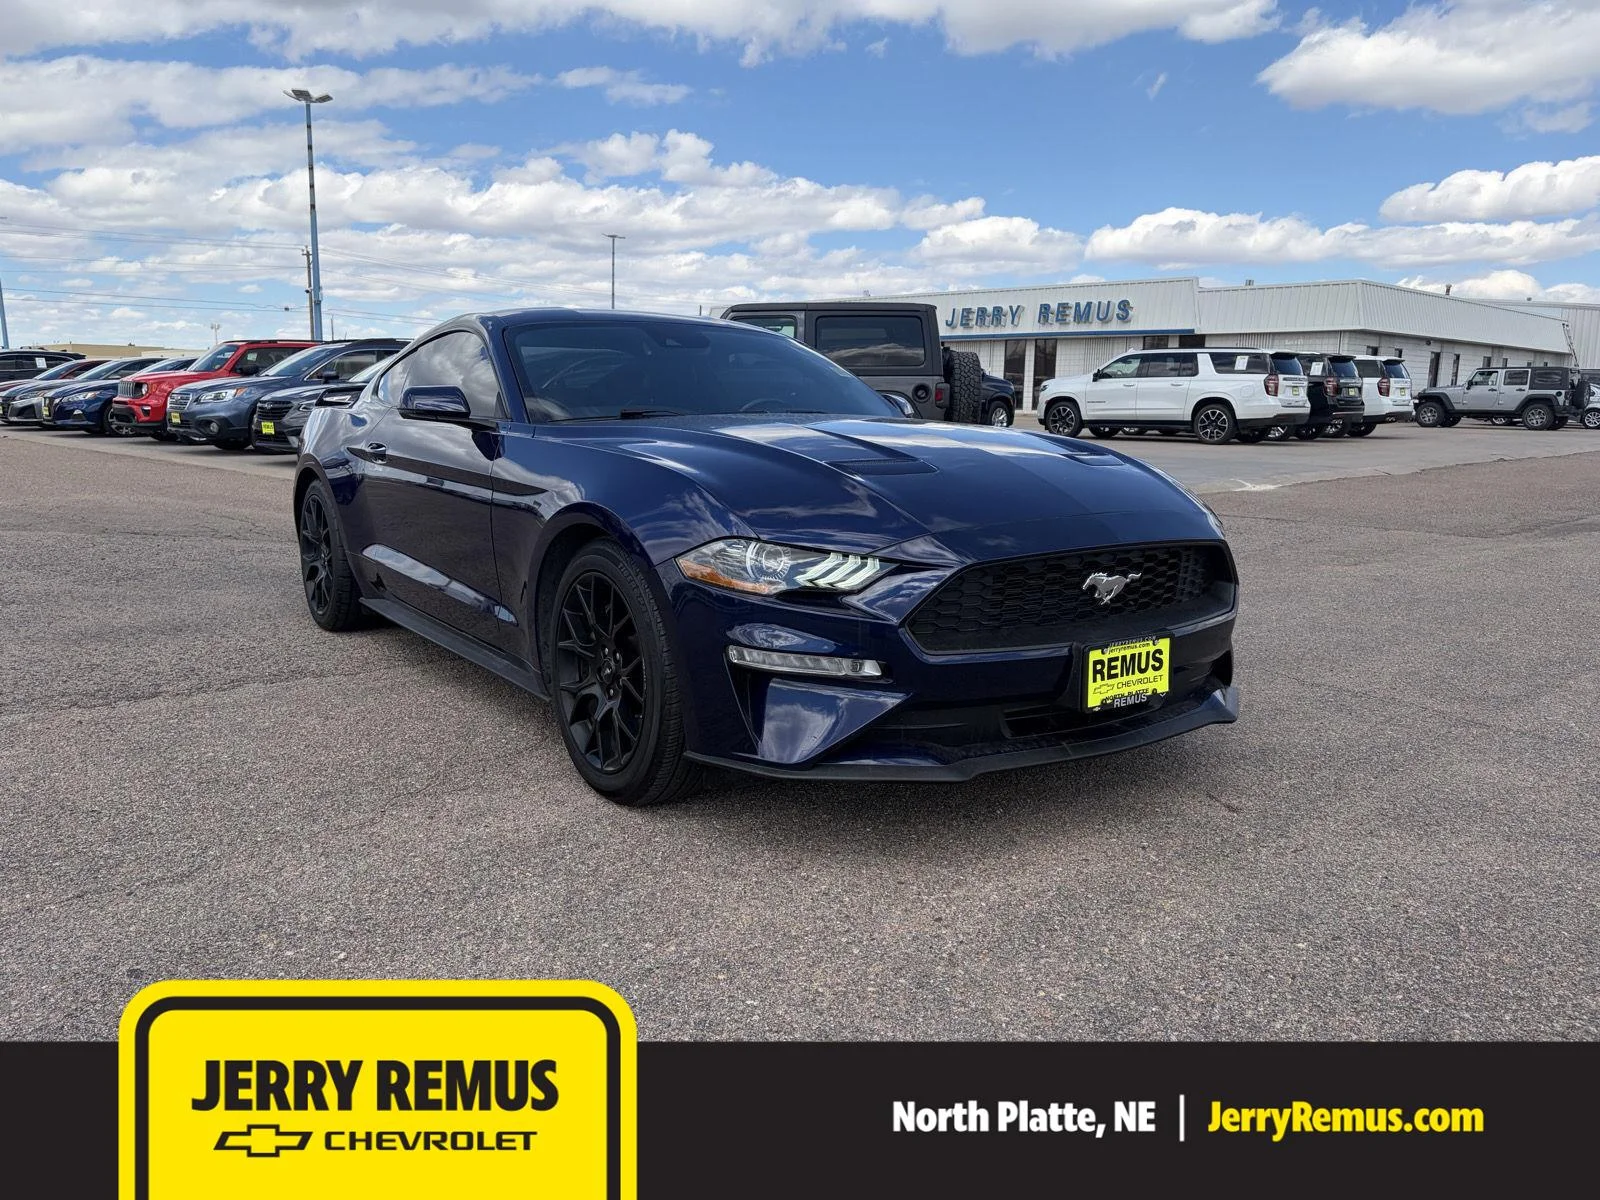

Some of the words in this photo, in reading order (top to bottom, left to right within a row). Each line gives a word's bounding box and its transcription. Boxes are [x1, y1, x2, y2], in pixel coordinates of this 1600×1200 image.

[945, 304, 1023, 328] JERRY
[1038, 299, 1132, 325] REMUS
[1108, 642, 1151, 655] jerryremus.com
[1092, 648, 1164, 683] REMUS
[1116, 674, 1163, 690] CHEVROLET
[1114, 693, 1147, 709] REMUS
